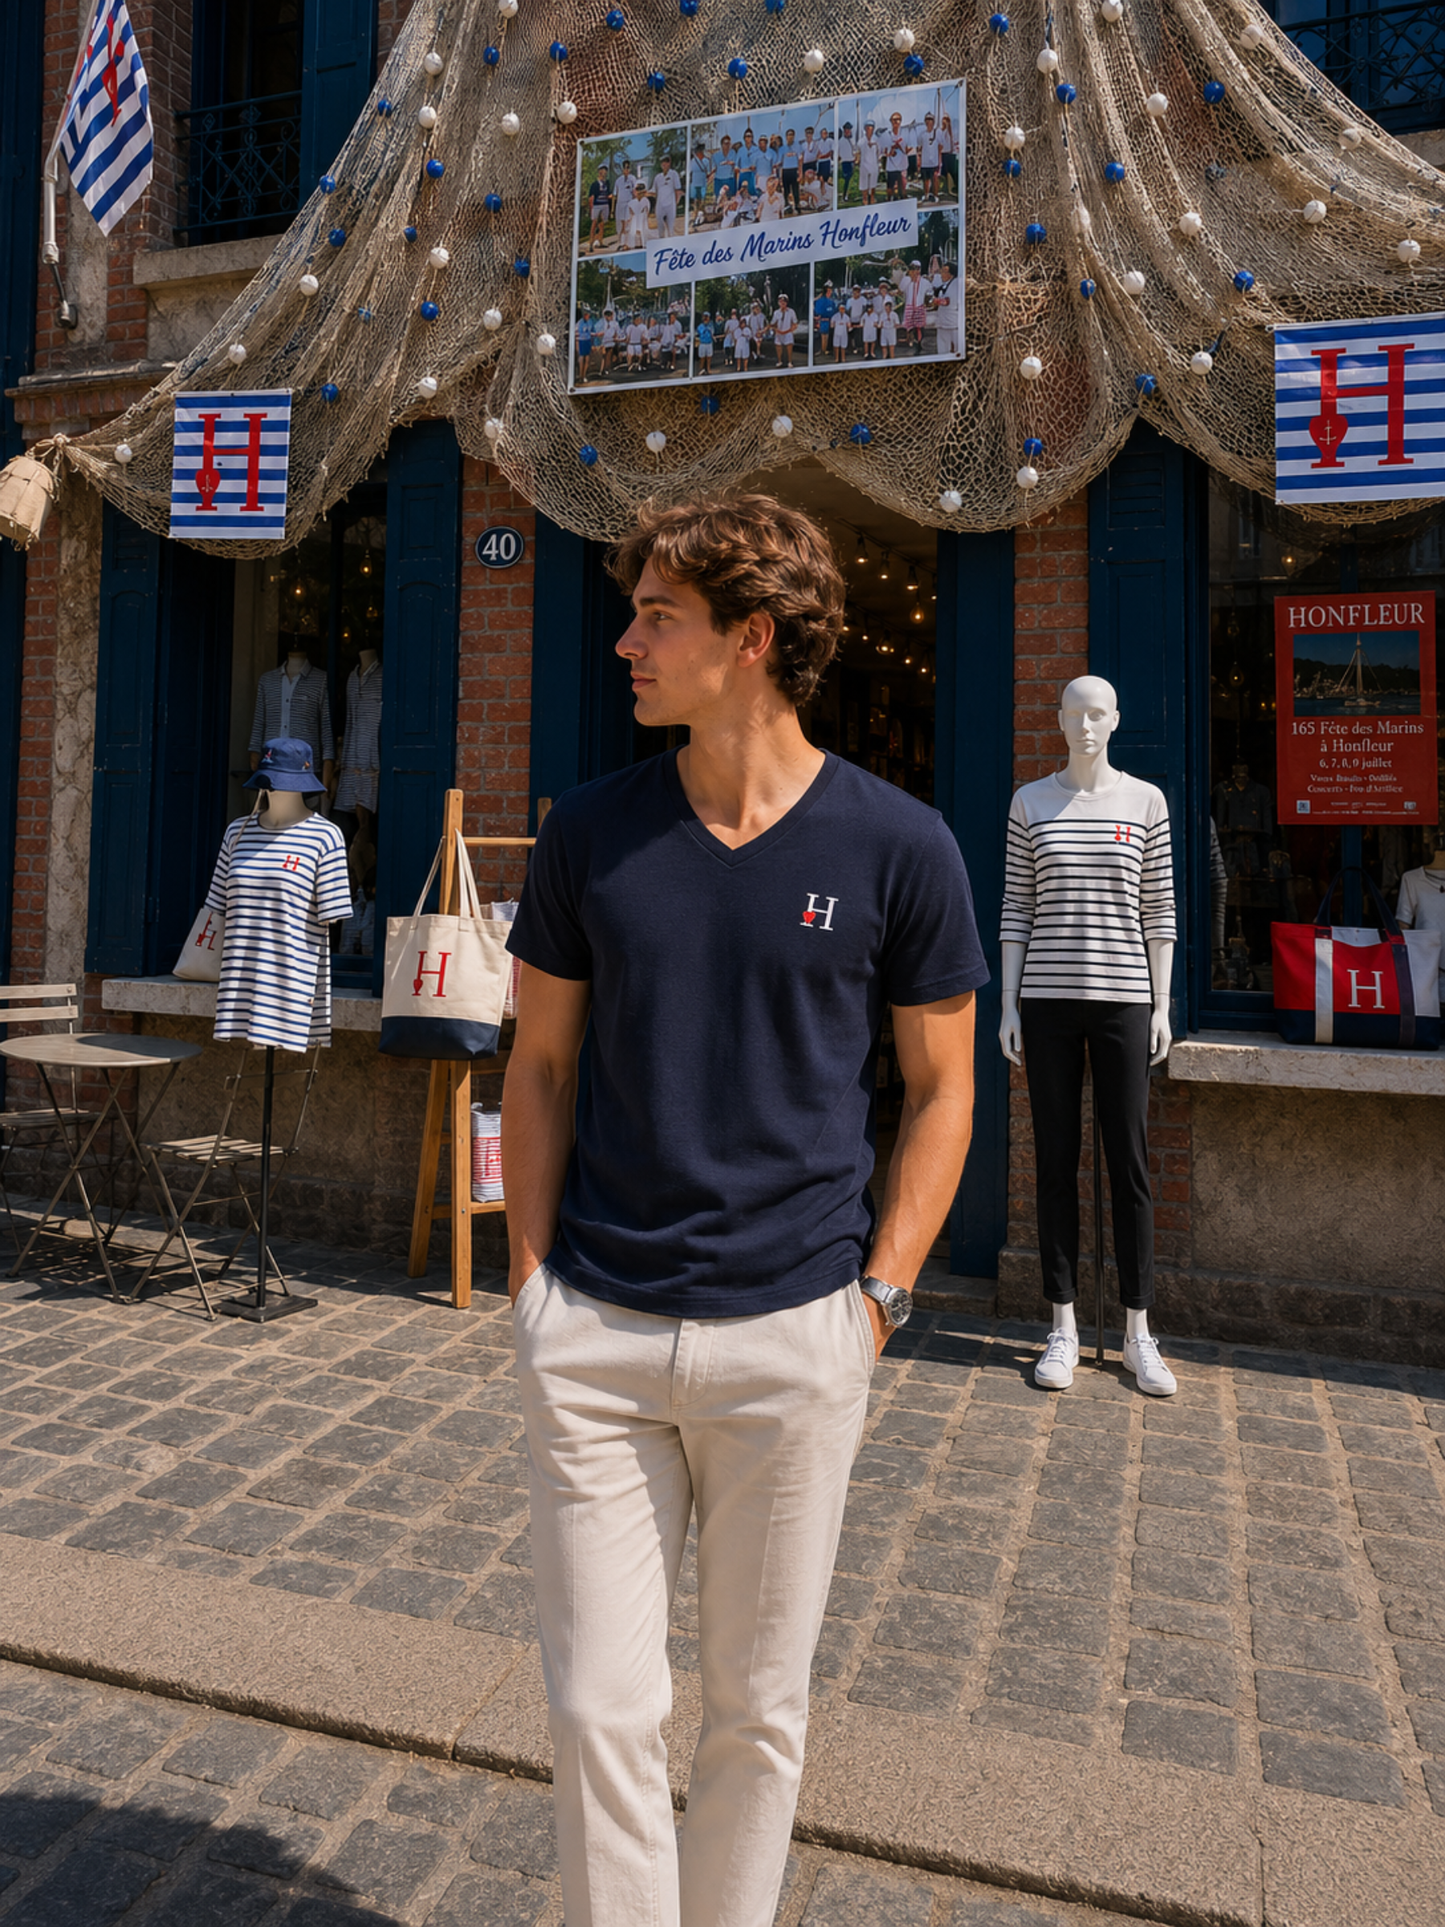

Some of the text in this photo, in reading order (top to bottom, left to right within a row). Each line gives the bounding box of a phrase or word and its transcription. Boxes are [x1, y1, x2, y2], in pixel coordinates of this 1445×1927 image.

[653, 212, 912, 276] Fête des Marins Honfleur
[1309, 343, 1415, 469] H
[195, 412, 268, 512] H
[482, 533, 517, 561] 40
[1287, 602, 1426, 629] HONFLEUR
[1291, 720, 1425, 736] 165 Fête des Marins
[1332, 738, 1395, 753] Honfleur
[800, 892, 840, 931] H
[411, 950, 453, 998] H
[1346, 968, 1386, 1010] H
